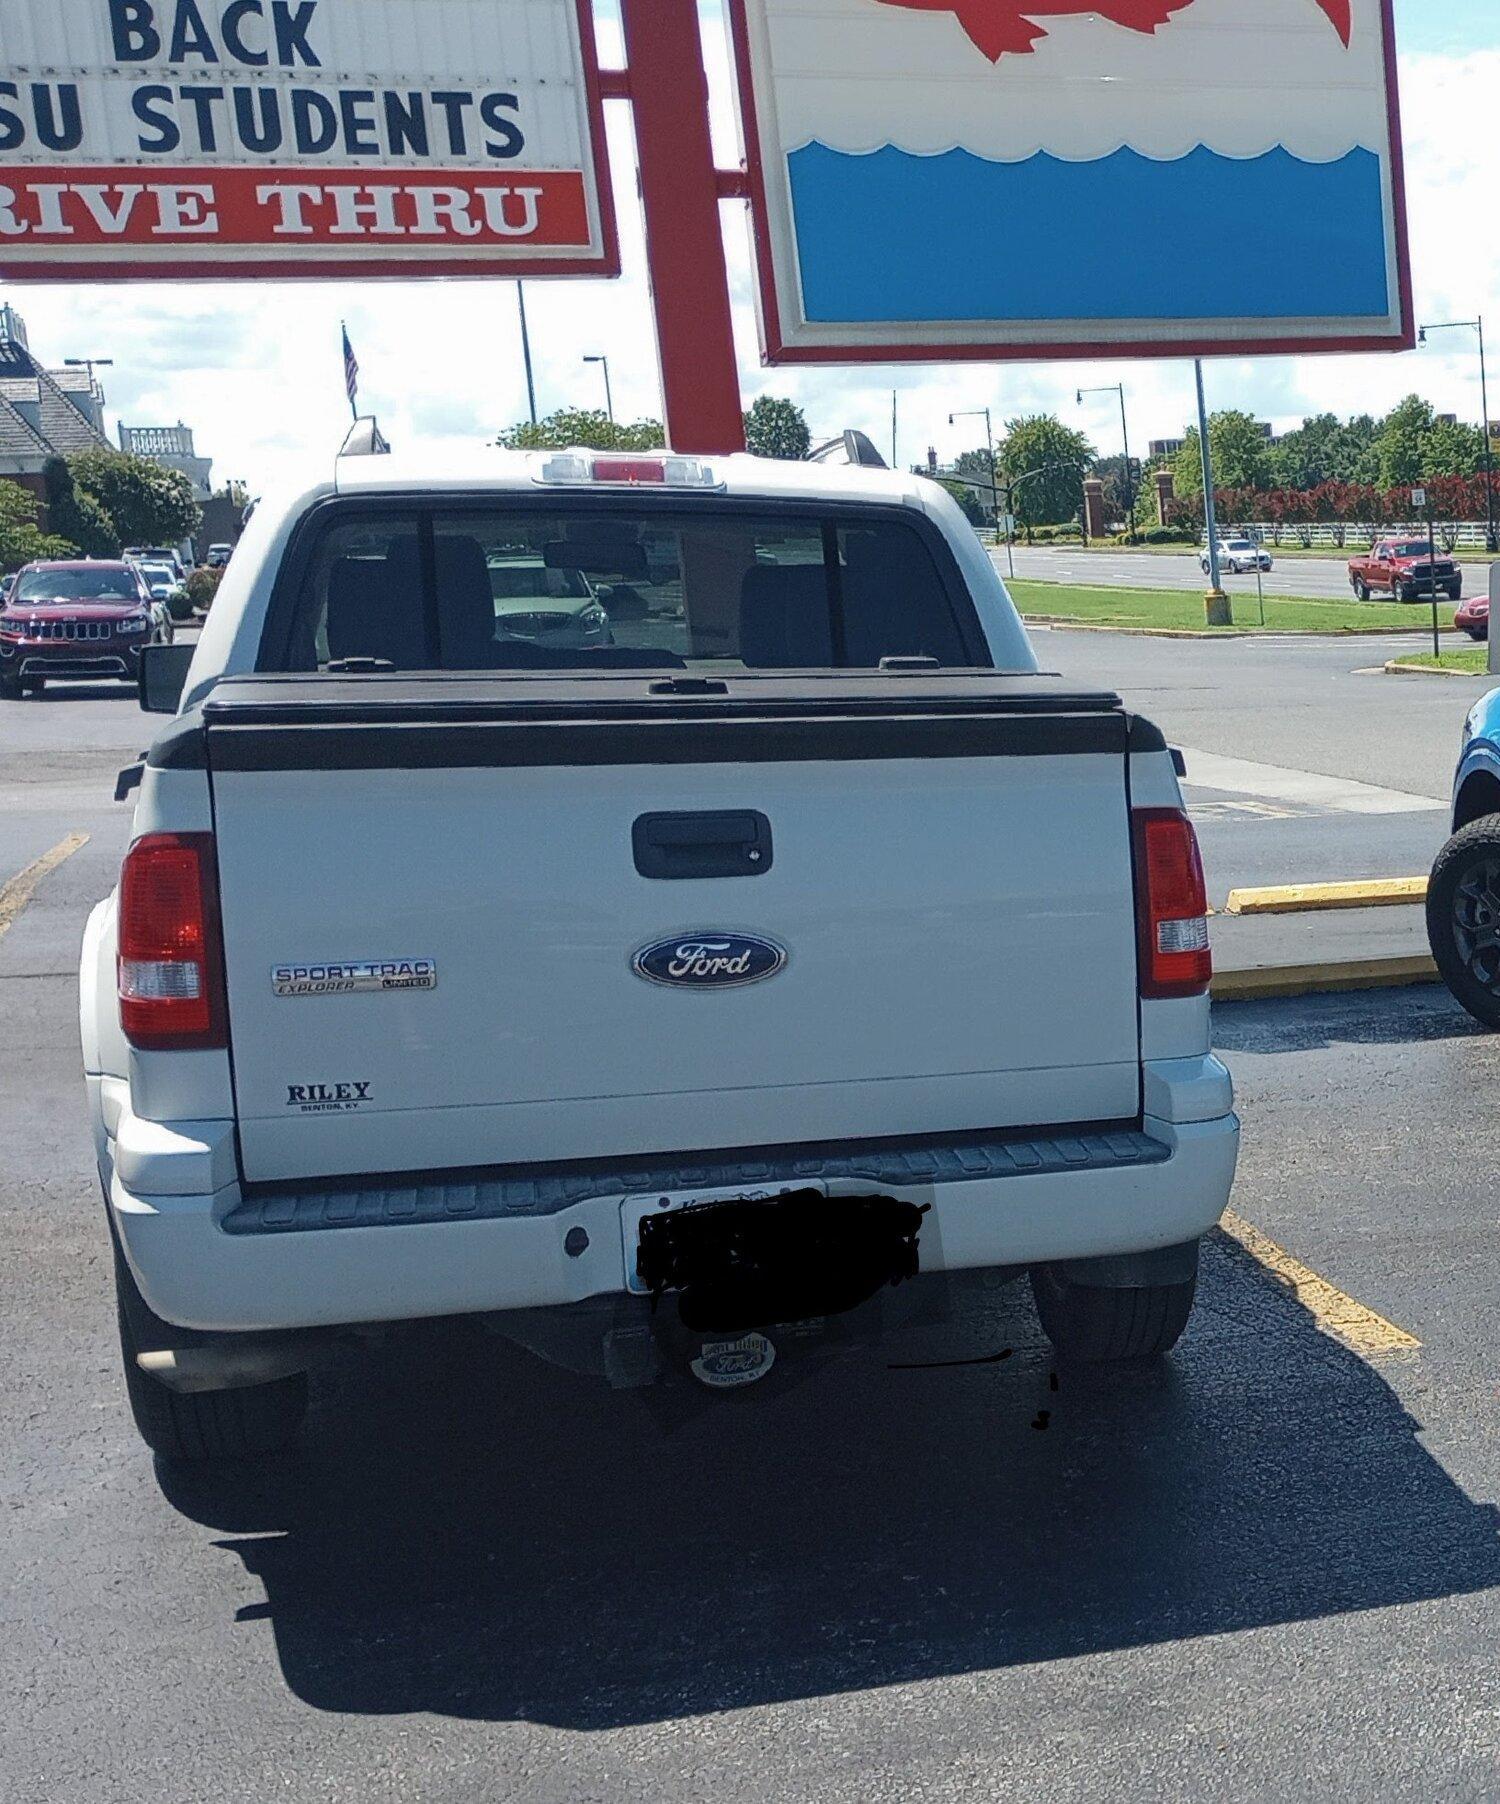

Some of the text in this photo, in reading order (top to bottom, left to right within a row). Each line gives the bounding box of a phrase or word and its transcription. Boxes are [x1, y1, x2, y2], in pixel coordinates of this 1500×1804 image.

[109, 0, 322, 67] BACK
[131, 84, 524, 158] STUDENTS
[257, 185, 543, 236] THRU
[276, 962, 429, 982] SPORT TRAC
[668, 942, 751, 977] Ford
[278, 978, 431, 994] EXPLORER LIMITED
[287, 1081, 370, 1101] RILEY
